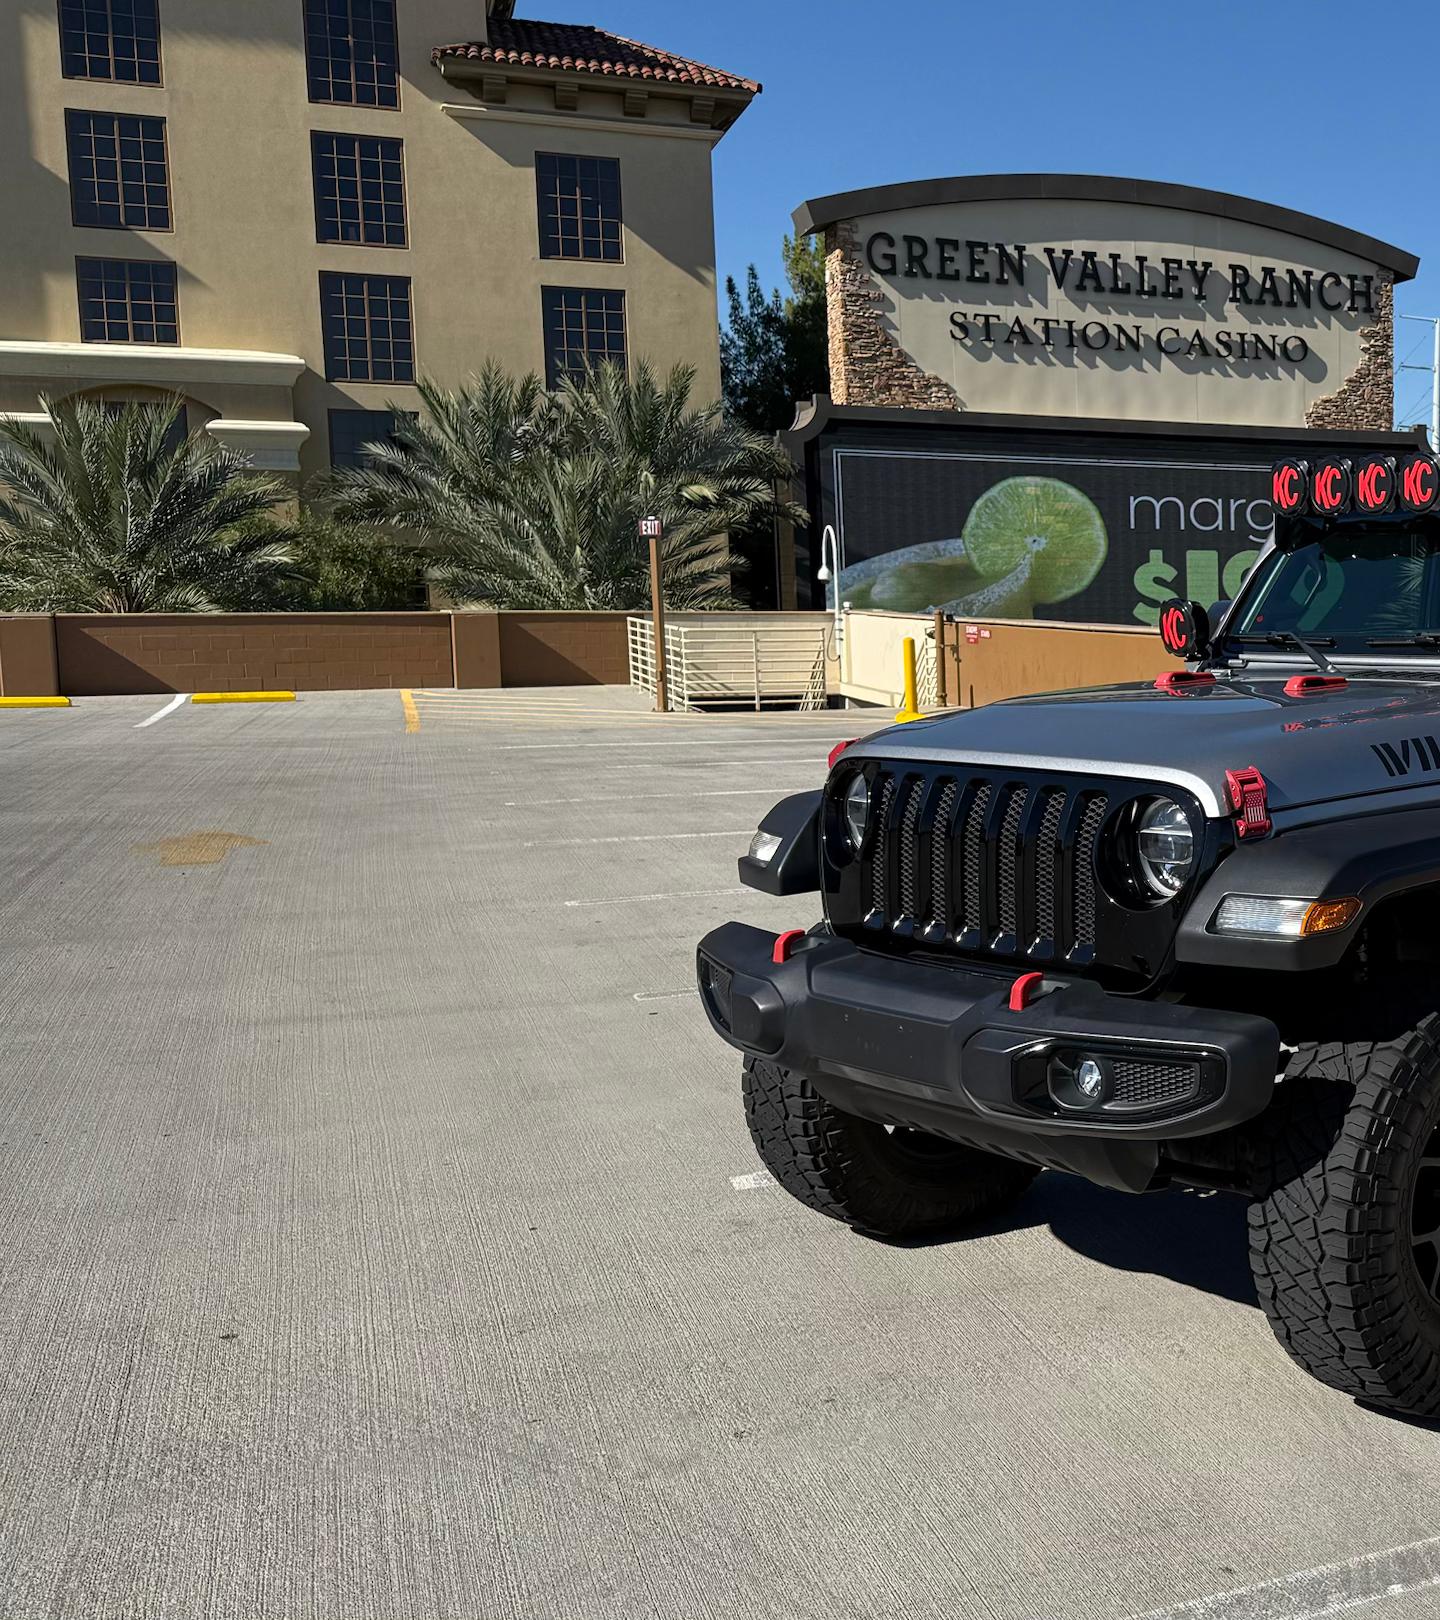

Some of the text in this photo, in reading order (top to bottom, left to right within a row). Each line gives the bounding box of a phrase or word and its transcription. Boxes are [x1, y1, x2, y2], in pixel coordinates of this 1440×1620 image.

[866, 232, 1376, 314] GREEN VALLEY RANCH
[949, 312, 1310, 363] STATION CASINO
[1273, 466, 1299, 509] KC
[1314, 466, 1342, 509] KC
[1358, 463, 1387, 508] KC
[1403, 460, 1433, 505] KC
[642, 520, 660, 535] EXIT
[1161, 607, 1187, 651] KC
